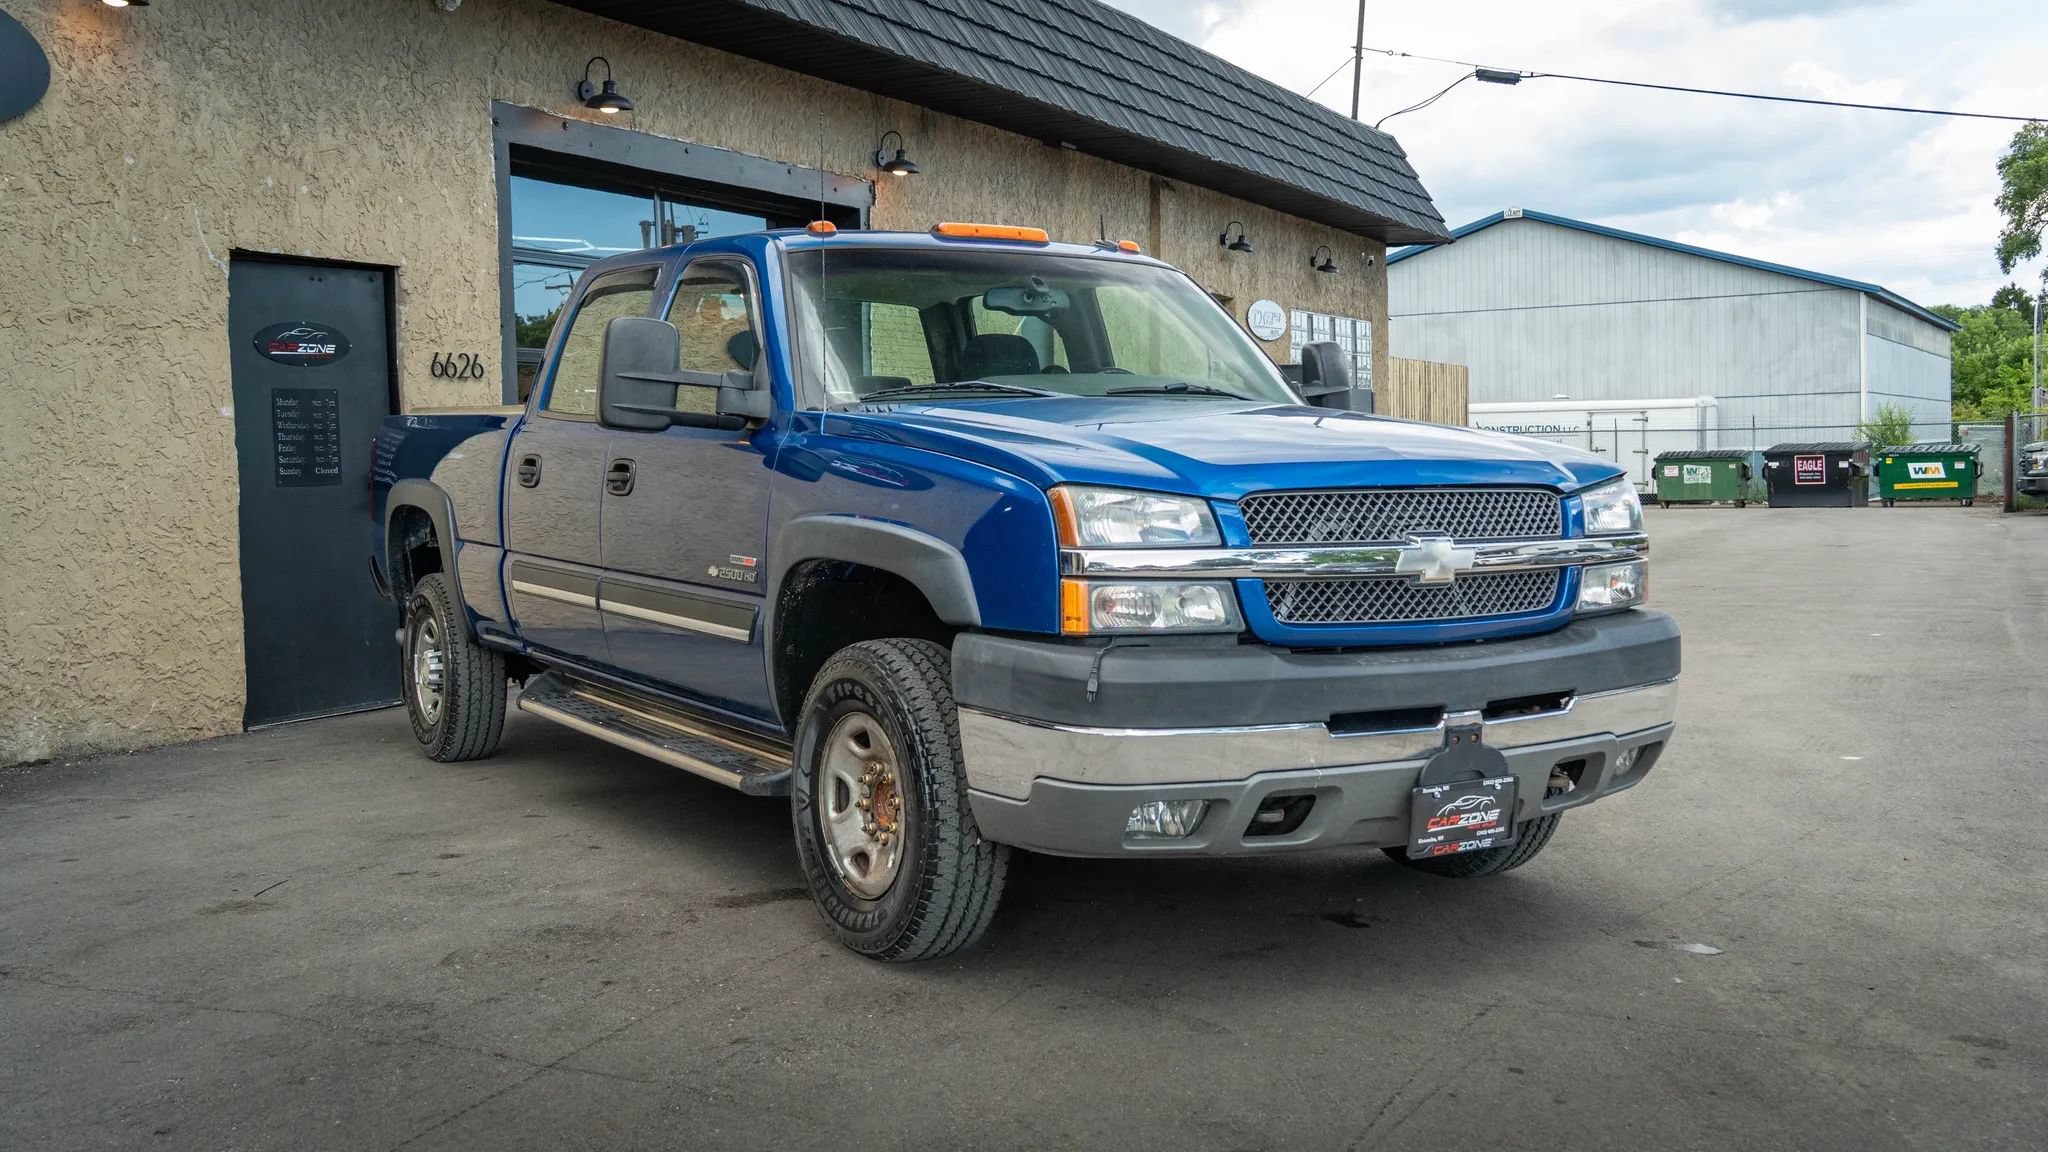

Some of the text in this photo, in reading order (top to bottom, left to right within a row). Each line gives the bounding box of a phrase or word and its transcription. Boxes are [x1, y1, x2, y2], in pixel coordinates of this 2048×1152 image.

[431, 352, 484, 379] 6626
[276, 398, 300, 409] Monday
[276, 409, 301, 420] Tuesday
[277, 421, 310, 431] Wednesday
[1479, 425, 1561, 434] ONSTRUCTION
[277, 432, 305, 443] Thursday
[278, 444, 297, 454] Friday
[279, 456, 306, 466] Saturday
[1797, 460, 1823, 472] EAGLE
[280, 467, 339, 477] Sunday Closed
[1913, 467, 1941, 475] WM
[720, 567, 743, 580] 2500
[1426, 809, 1501, 829] CARZONE
[1432, 838, 1493, 856] CARZONE
